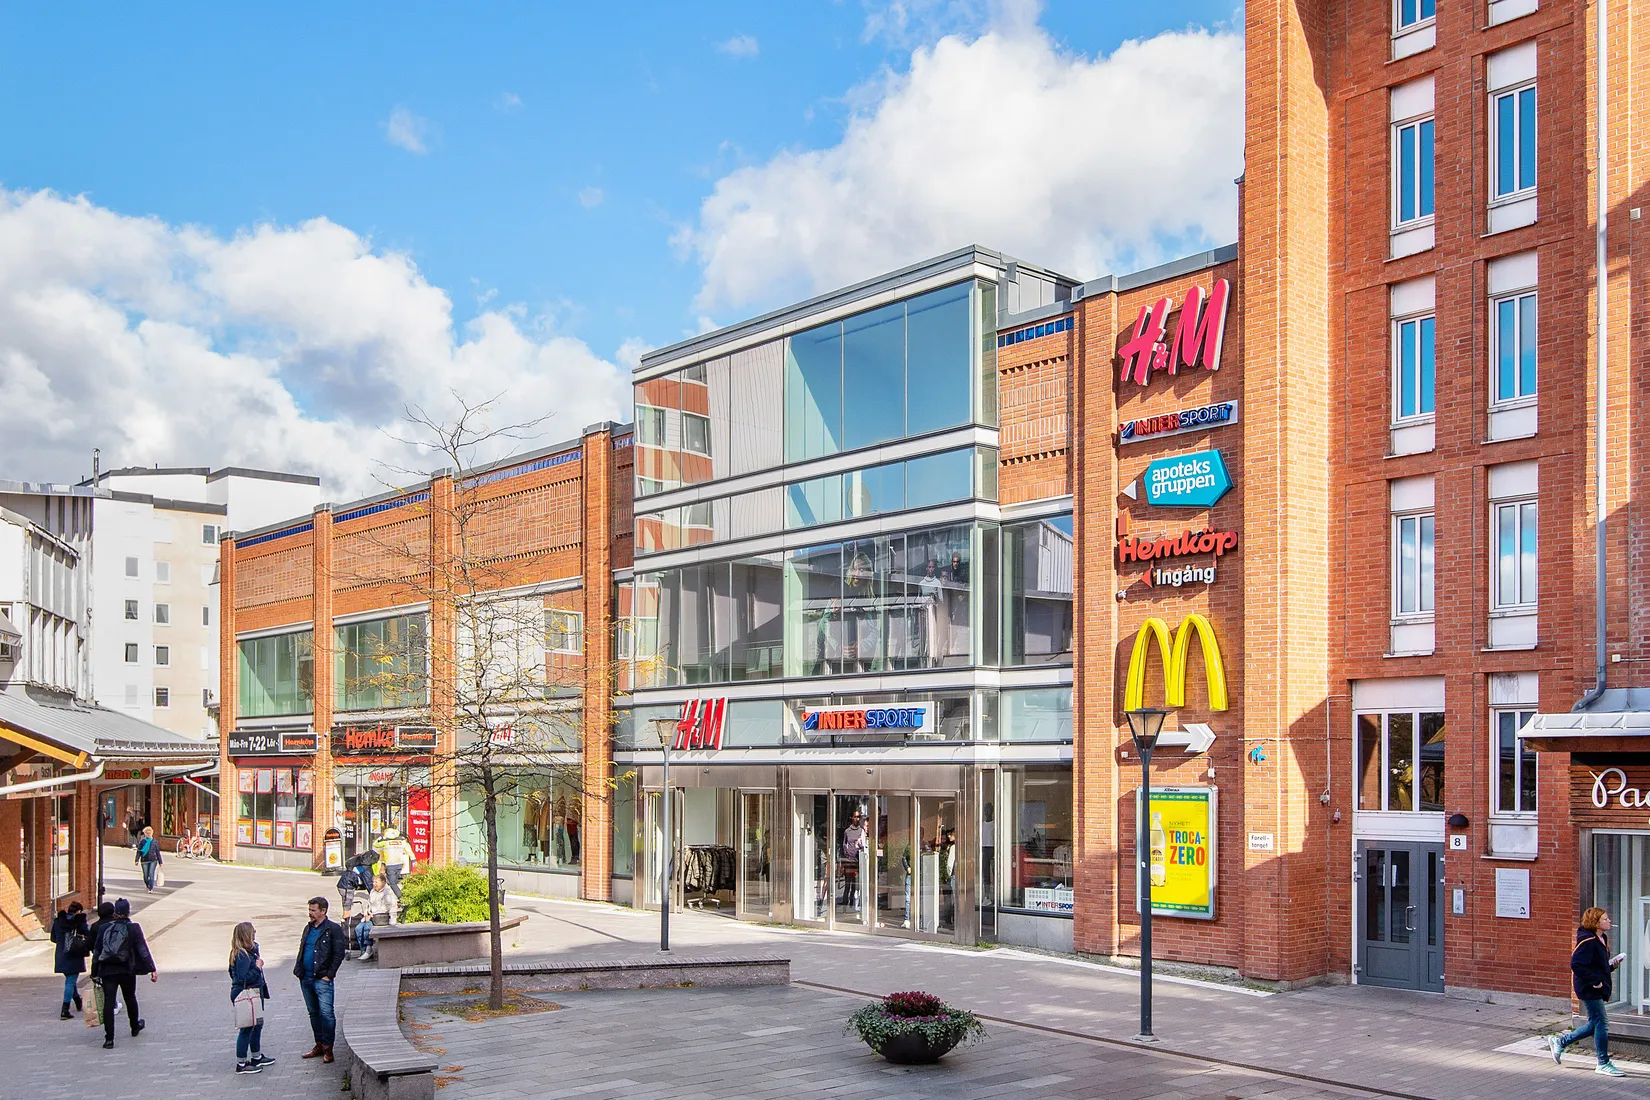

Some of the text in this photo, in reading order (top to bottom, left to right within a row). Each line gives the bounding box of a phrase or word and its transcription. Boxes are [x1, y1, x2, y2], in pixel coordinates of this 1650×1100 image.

[1118, 278, 1229, 386] H&M
[1133, 403, 1233, 436] INTERSPORT
[1152, 460, 1211, 483] apoteks
[1151, 473, 1216, 499] gruppen
[1119, 526, 1238, 563] Hemköp
[1156, 565, 1215, 587] Ingång
[675, 696, 728, 751] H&M
[818, 707, 927, 730] INTERSPORT
[1169, 830, 1206, 845] TROCA-
[1454, 837, 1461, 847] 8
[1169, 845, 1205, 867] ZERO
[1041, 901, 1073, 909] INTERSPOR
